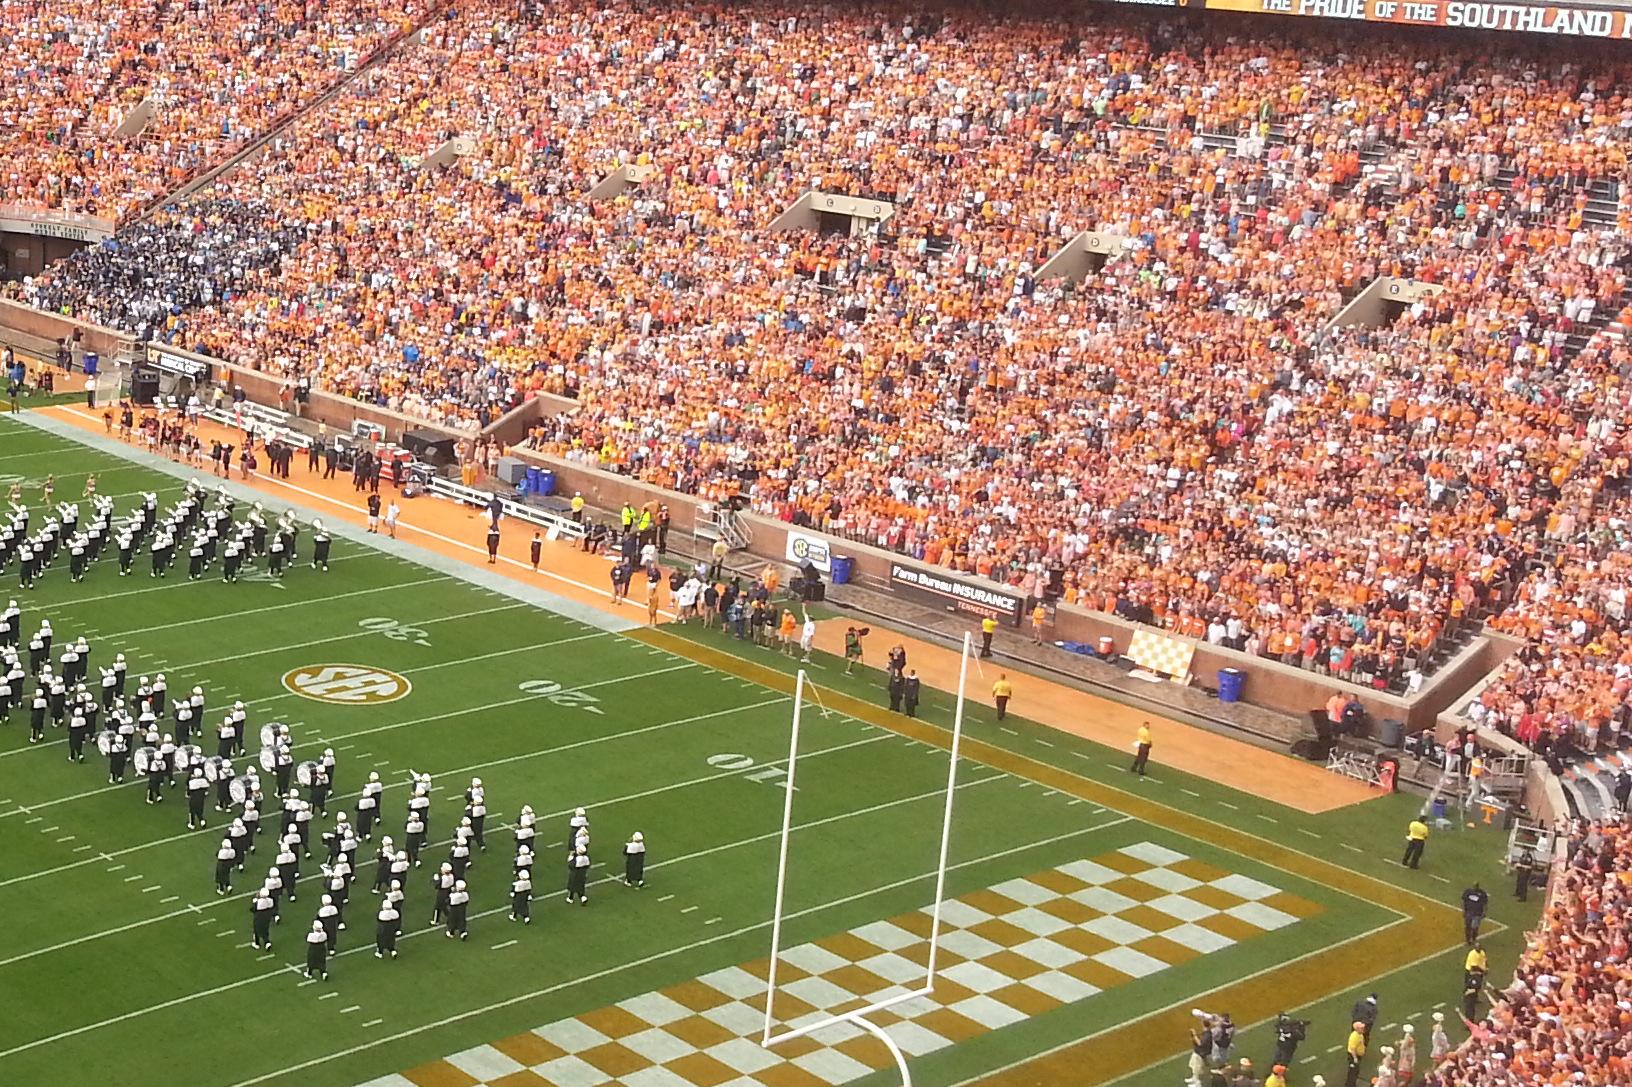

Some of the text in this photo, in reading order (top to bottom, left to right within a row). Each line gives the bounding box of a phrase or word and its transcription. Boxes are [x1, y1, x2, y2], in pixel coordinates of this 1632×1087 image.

[1263, 0, 1291, 11] THE
[1298, 0, 1366, 20] PRIDE
[1375, 1, 1396, 18] OF
[1403, 3, 1437, 21] THE
[1446, 2, 1613, 37] SOUTHLAND
[892, 565, 1016, 611] Farm Bureau INSURANCE
[357, 616, 429, 642] 30
[293, 666, 399, 701] SEC
[517, 679, 601, 708] 20
[706, 753, 789, 784] 10
